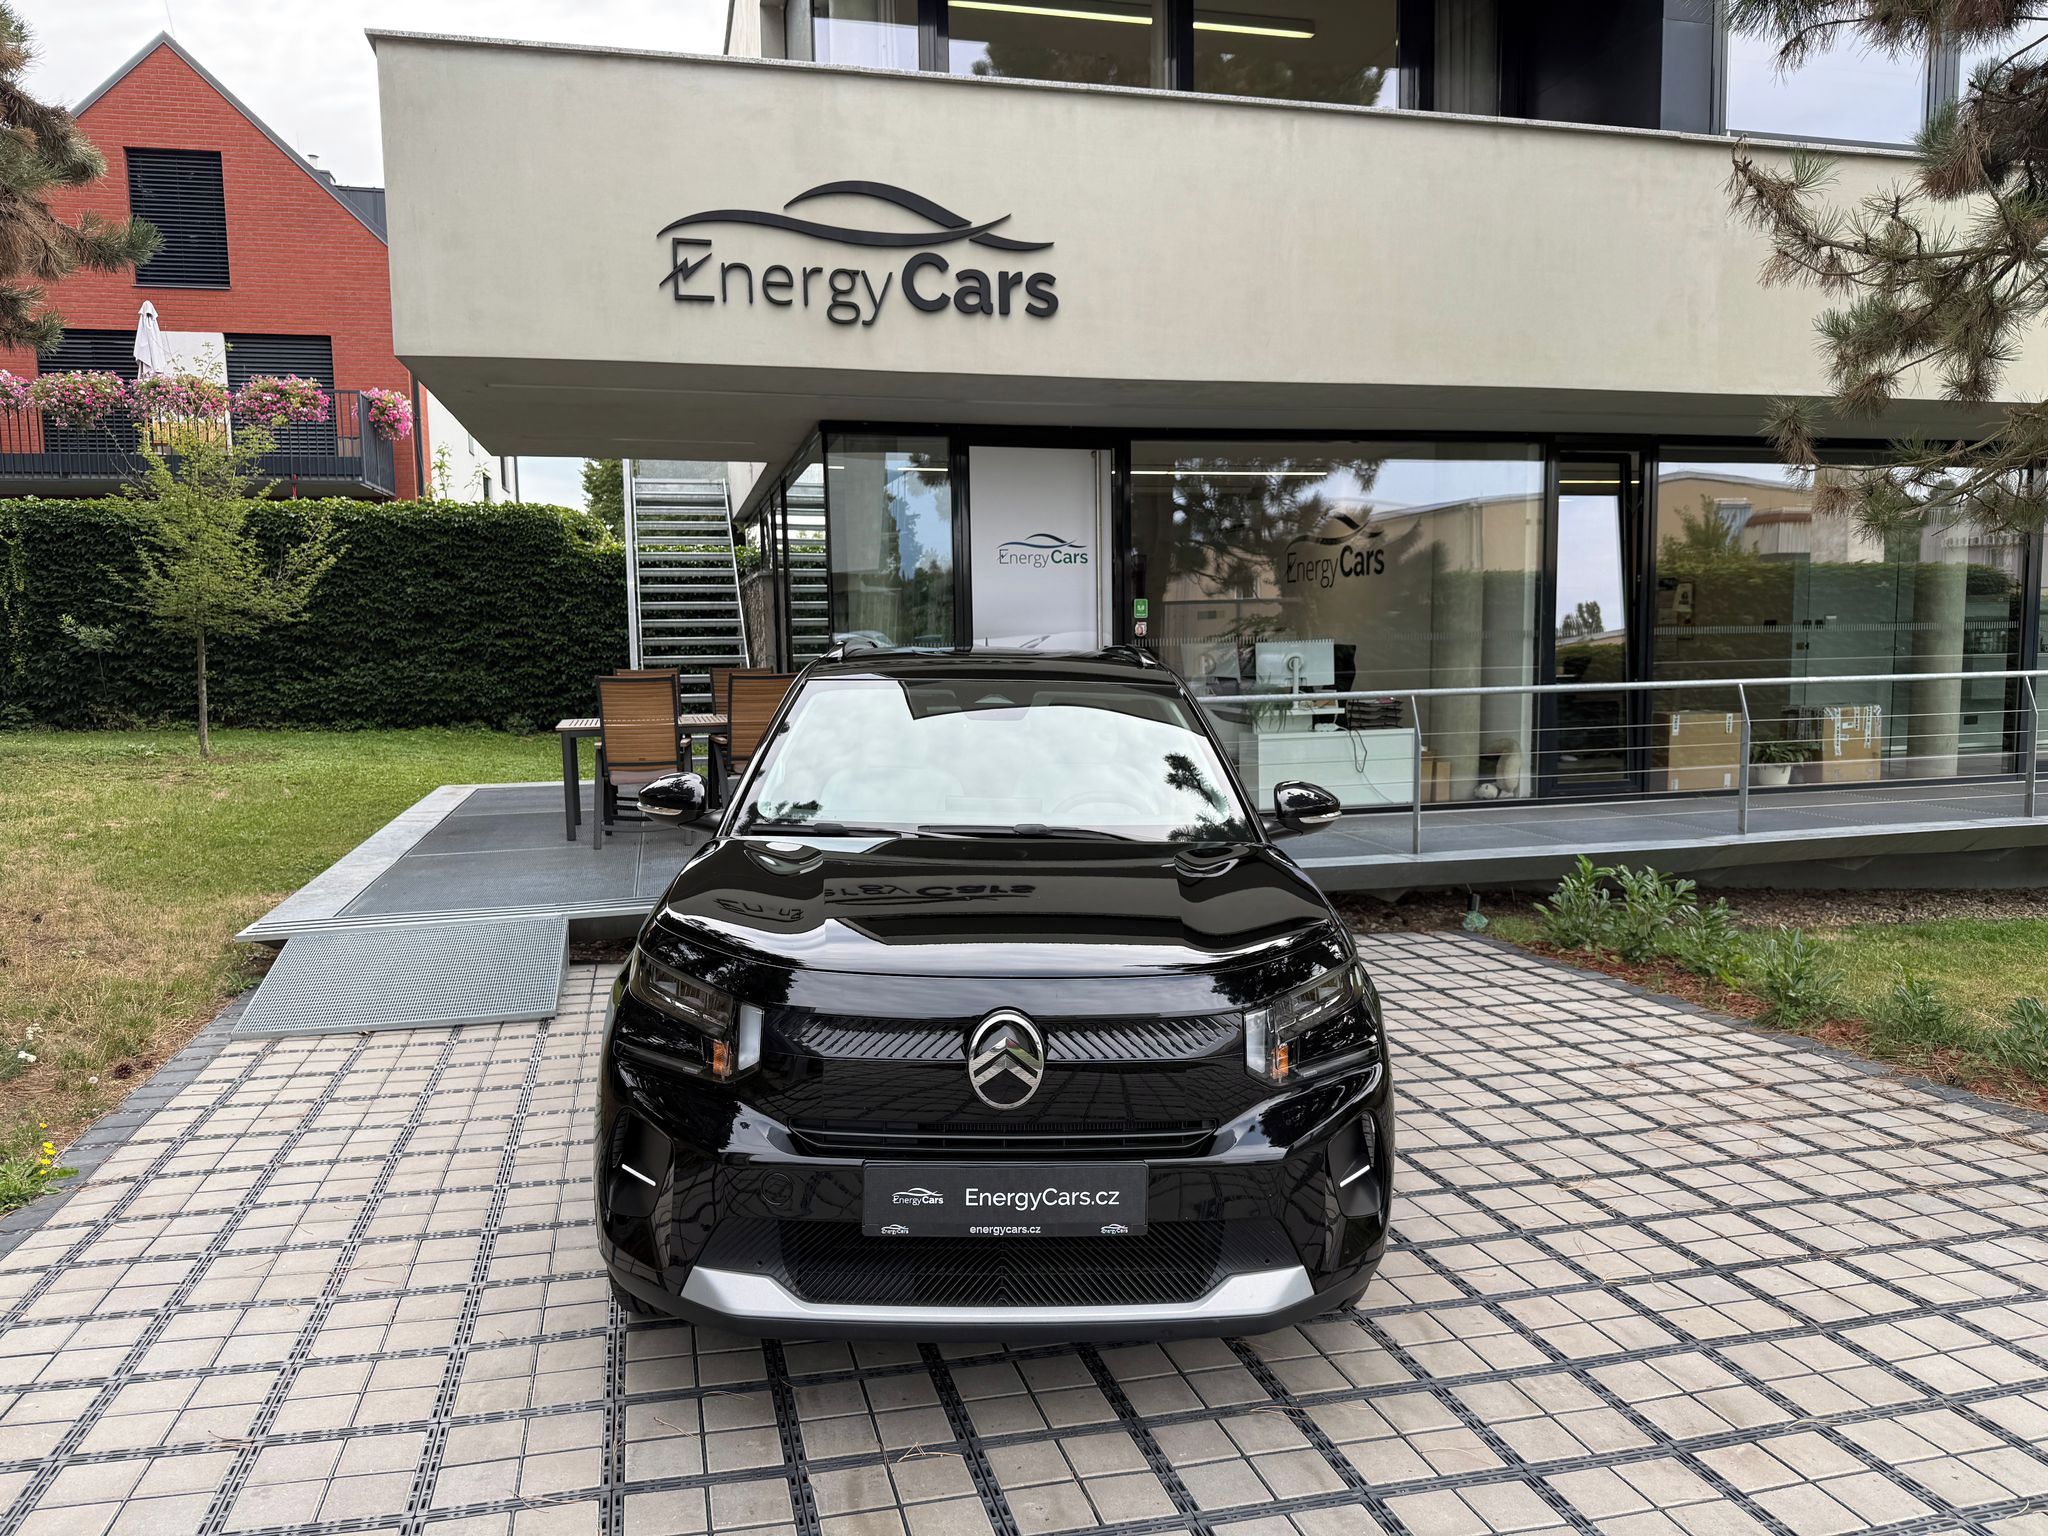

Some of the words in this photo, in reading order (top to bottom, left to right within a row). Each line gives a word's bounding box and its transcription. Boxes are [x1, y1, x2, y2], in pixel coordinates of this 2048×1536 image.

[659, 237, 1060, 326] EnergyCars
[998, 548, 1089, 568] EnergyCars
[1285, 544, 1385, 589] EnergyCars
[893, 1196, 944, 1206] EnergyCars
[965, 1188, 1120, 1211] EnergyCars.cz
[969, 1226, 1041, 1236] energycars.cz
